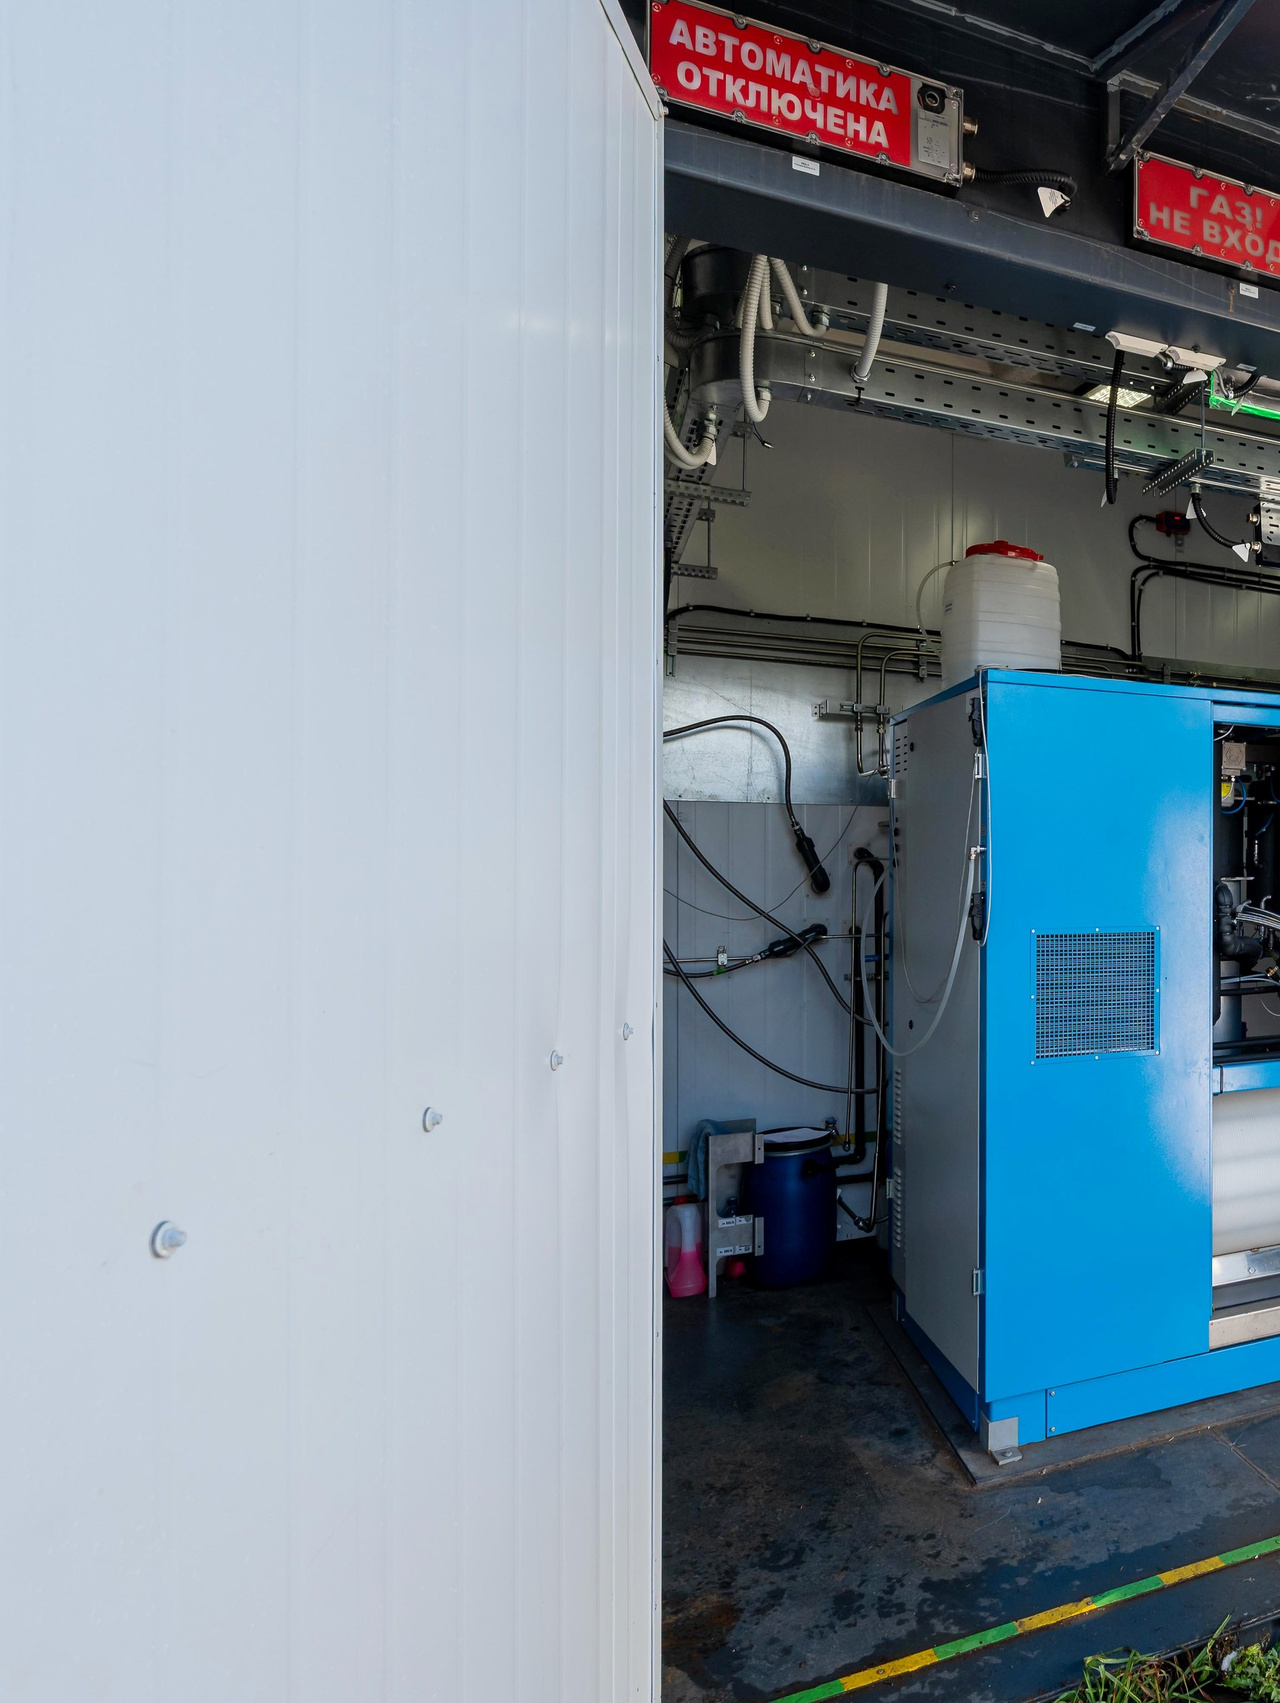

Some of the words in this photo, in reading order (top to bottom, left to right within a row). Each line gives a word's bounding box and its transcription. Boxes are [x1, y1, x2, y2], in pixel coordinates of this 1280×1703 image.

[668, 19, 899, 115] АВТОМАТИКА
[676, 61, 890, 148] ОТКЛЮЧЕНА
[1150, 202, 1192, 235] НЕ
[1189, 185, 1263, 229] ГАЗ!
